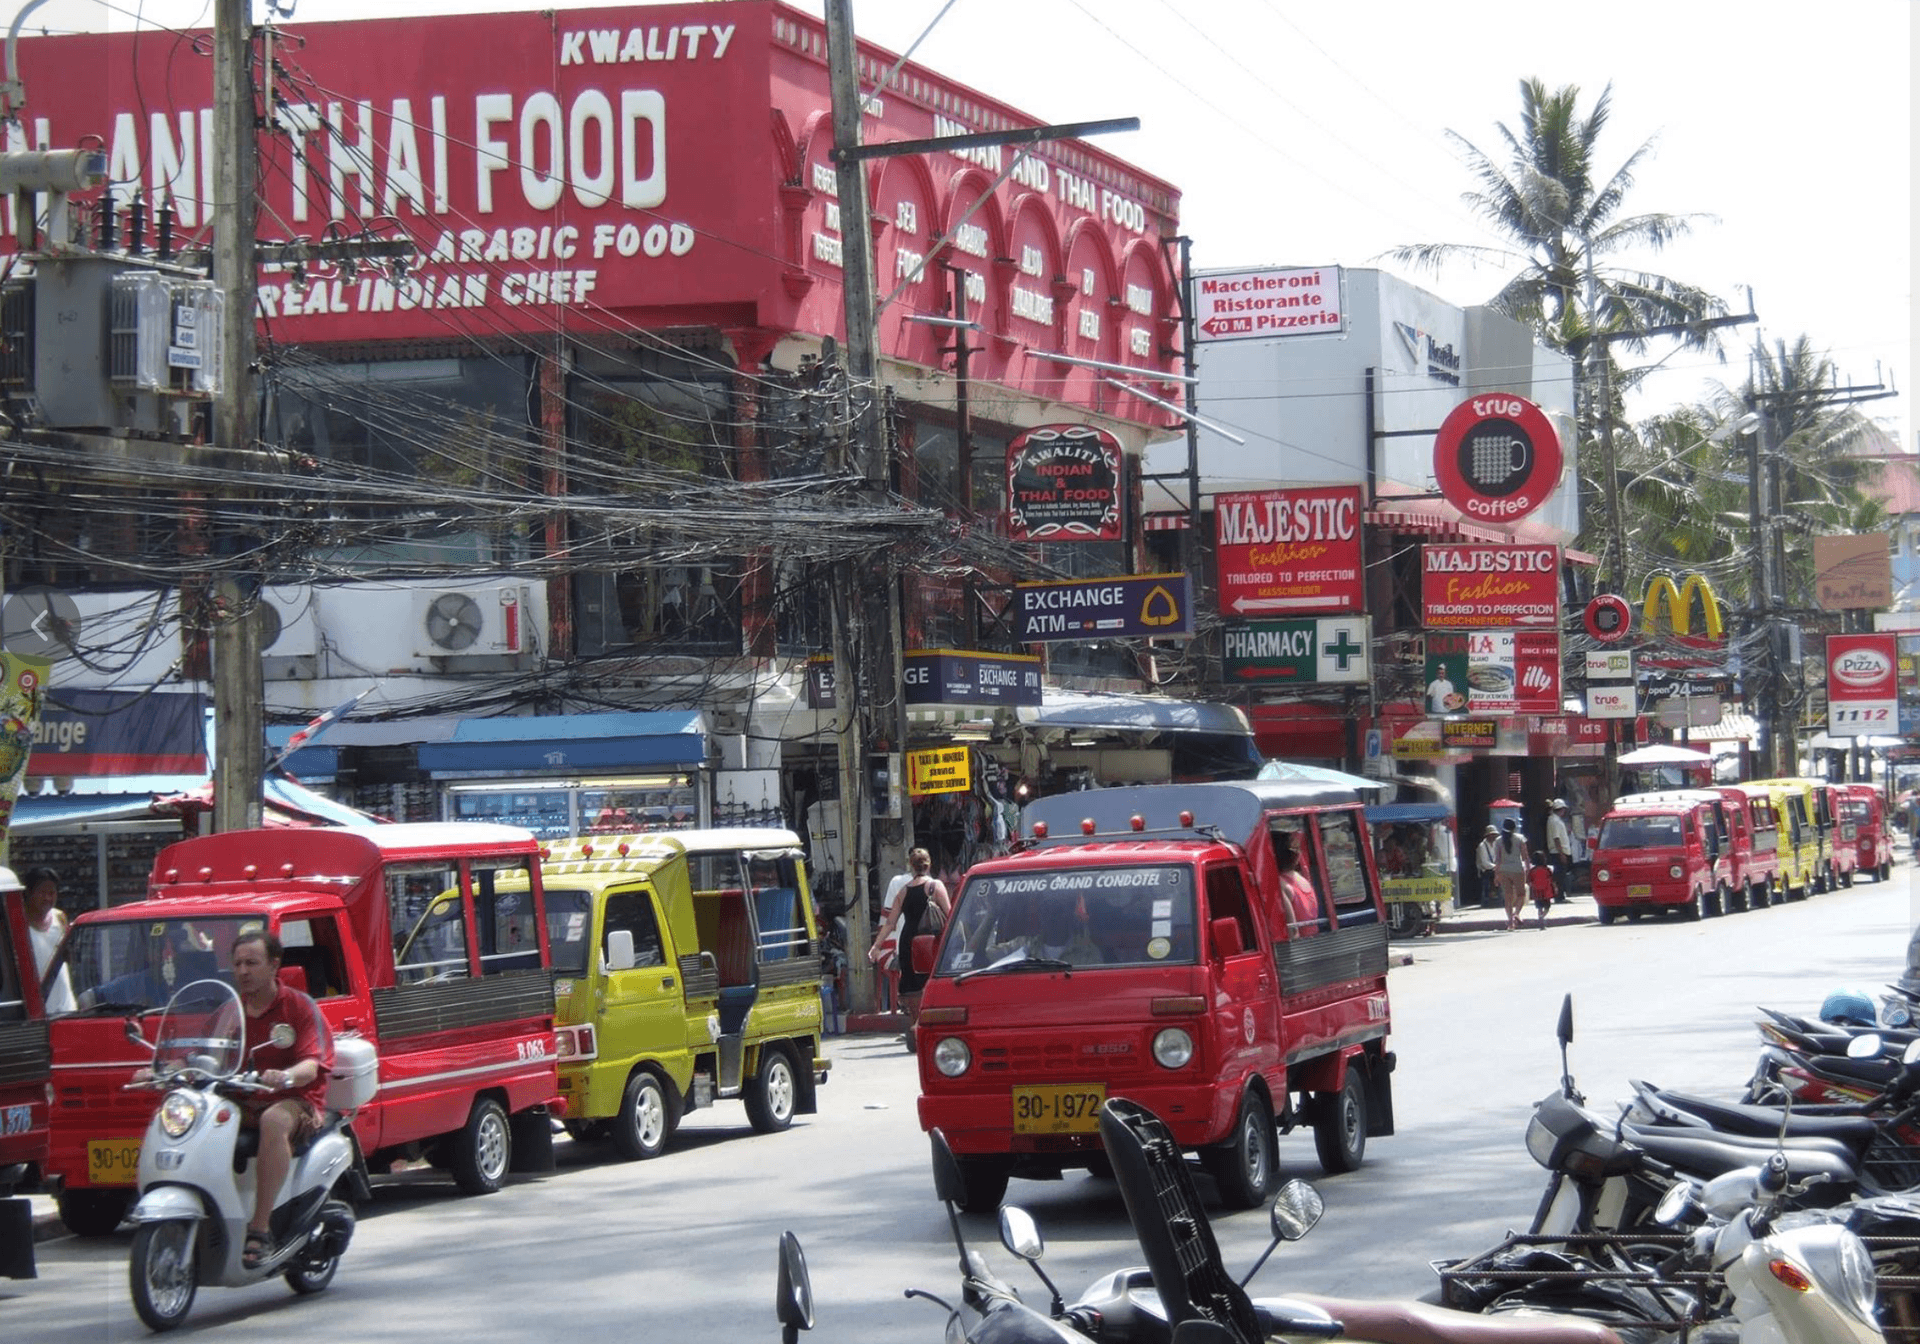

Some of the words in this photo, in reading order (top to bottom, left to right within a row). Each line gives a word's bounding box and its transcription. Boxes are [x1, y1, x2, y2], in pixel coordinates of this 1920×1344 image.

[560, 25, 736, 66] KWALITY
[275, 97, 449, 224] THAI
[476, 89, 668, 214] FOOD
[1009, 150, 1050, 194] AND
[1056, 168, 1097, 214] THAI
[1101, 189, 1145, 235] FOOD
[895, 201, 917, 235] SEA
[430, 226, 579, 264] ARABIC
[593, 223, 695, 259] FOOD
[1201, 272, 1321, 294] Maccheroni
[254, 281, 349, 318] REAL
[357, 273, 488, 313] INDIAN
[1214, 292, 1322, 313] Ristorante
[1211, 321, 1228, 333] 70
[1233, 319, 1250, 331] M.
[1256, 310, 1339, 329] Pizzeria
[1473, 399, 1522, 417] true
[1027, 447, 1101, 466] KWALITY
[1036, 465, 1093, 476] INDIAN
[1056, 477, 1066, 488] &
[1019, 490, 1057, 501] THAI
[1063, 489, 1110, 500] FOOD
[1467, 496, 1529, 516] coffee
[1219, 497, 1354, 545] MAJESTIC
[1426, 551, 1553, 572] MAJESTIC
[1227, 572, 1273, 584] TAILORED
[1279, 572, 1292, 582] TO
[1297, 569, 1355, 582] PERFECTION
[1447, 573, 1530, 602] Fashion
[1024, 587, 1124, 610] EXCHANGE
[1427, 604, 1474, 614] TAILORED
[1477, 604, 1492, 614] TO
[1493, 604, 1554, 614] PERFECTION
[1026, 614, 1066, 634] ATM
[1225, 630, 1313, 658] PHARMACY
[1587, 660, 1607, 669] true
[1843, 659, 1882, 671] PIZZA
[979, 669, 1017, 686] EXCHANGE
[1024, 672, 1038, 687] ATM
[1522, 665, 1552, 693] illy
[1594, 695, 1619, 704] true
[1648, 688, 1670, 696] open
[1670, 682, 1691, 698] 24
[1691, 684, 1713, 692] hours
[1605, 703, 1628, 711] move
[1835, 708, 1889, 721] 1112
[33, 720, 86, 752] ange
[977, 881, 989, 897] 3
[1049, 875, 1093, 891] GRAND
[1096, 872, 1160, 888] CONDOTEL
[1168, 869, 1180, 885] 3
[517, 1042, 525, 1060] B
[1018, 1094, 1099, 1119] 30-1972
